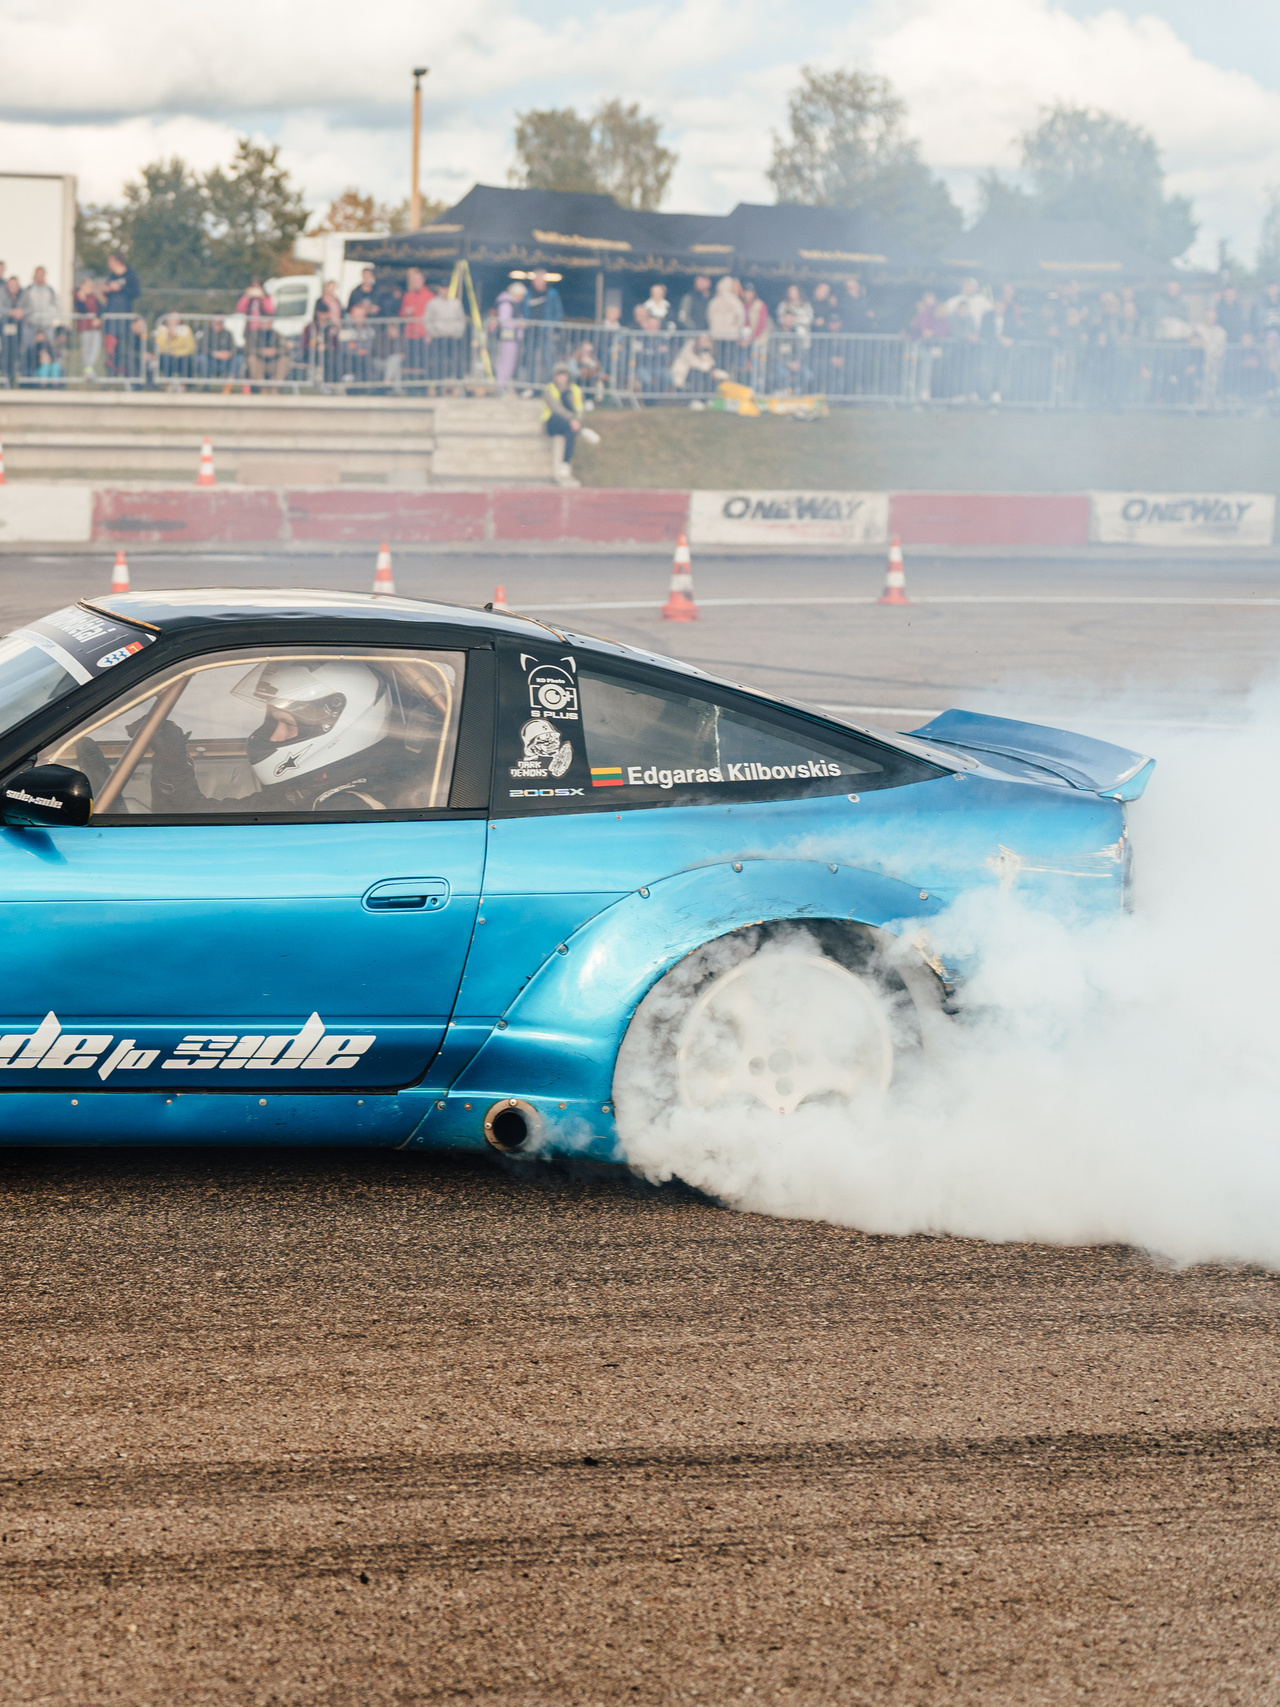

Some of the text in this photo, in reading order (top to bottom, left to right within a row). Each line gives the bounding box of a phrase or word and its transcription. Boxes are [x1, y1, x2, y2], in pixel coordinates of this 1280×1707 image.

[543, 710, 579, 720] PLUS
[517, 761, 542, 769] DARK
[510, 768, 548, 778] DEMONS
[627, 760, 842, 789] Edgaras Kilbovskis
[509, 788, 585, 798] 200SX
